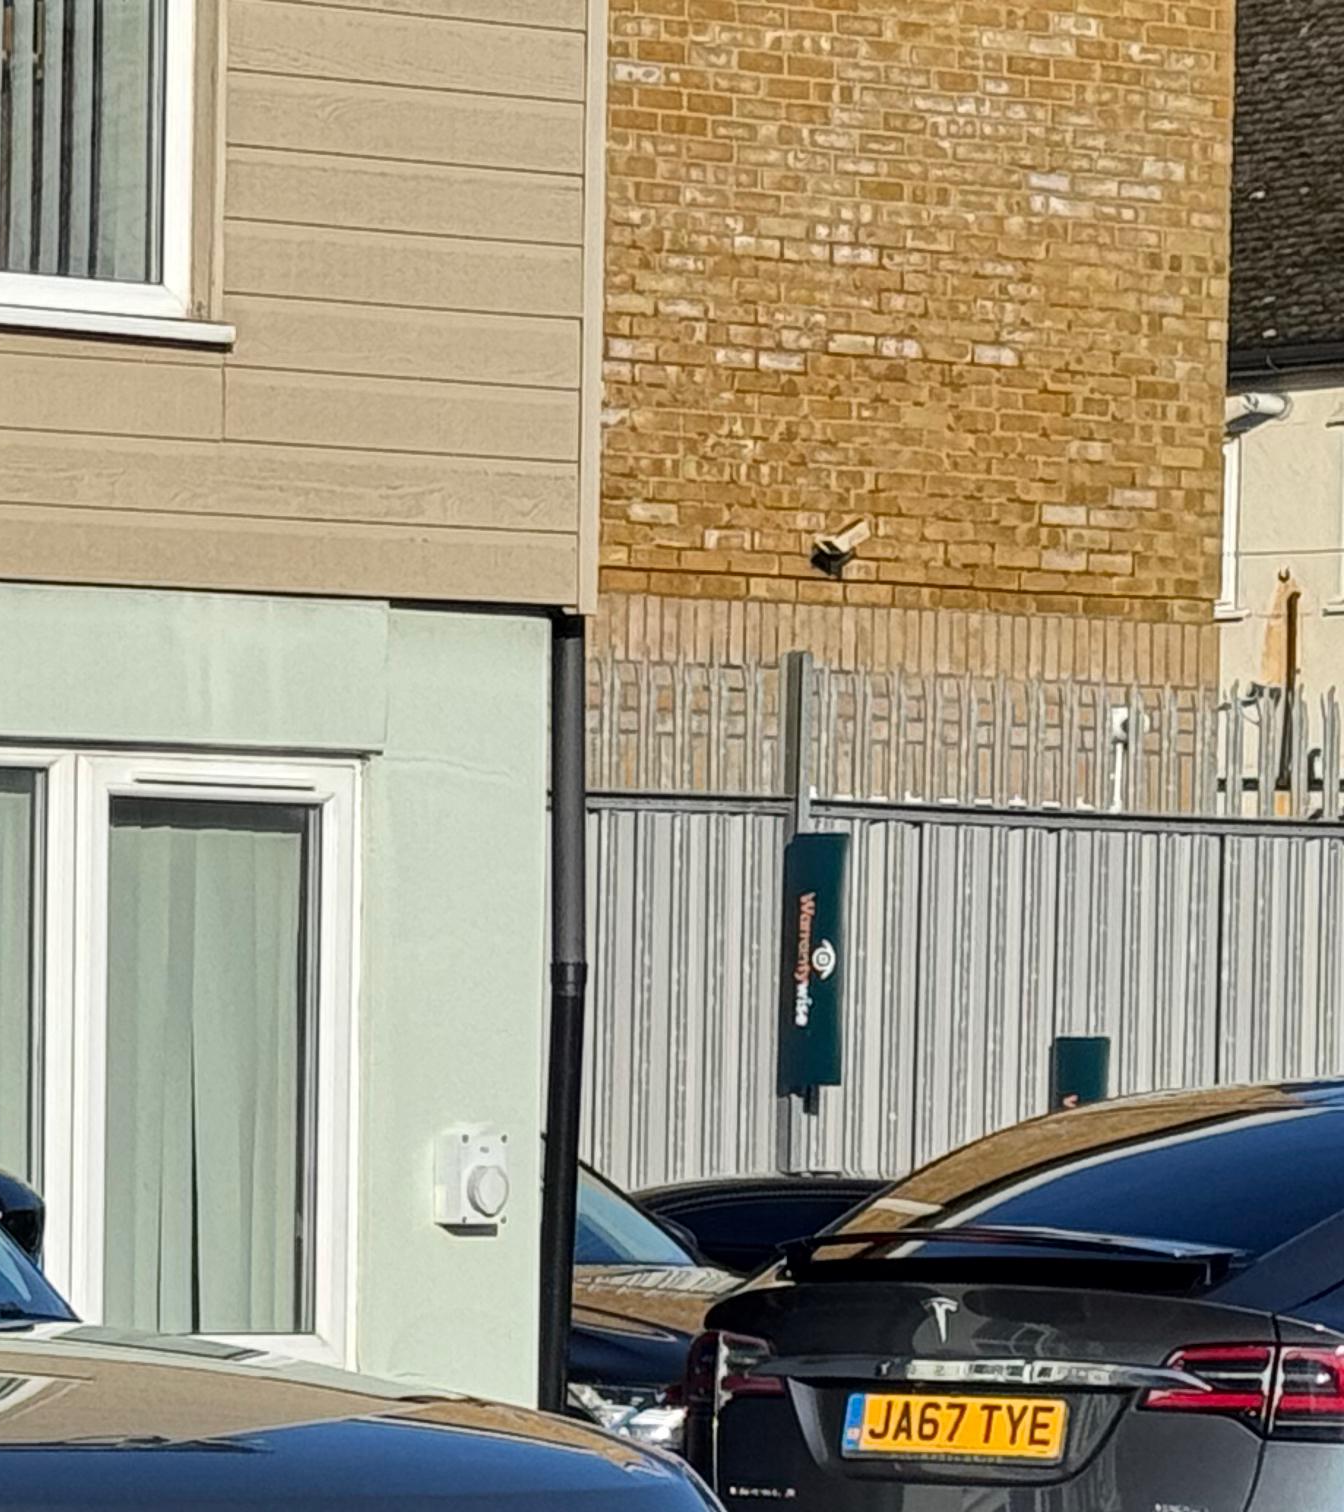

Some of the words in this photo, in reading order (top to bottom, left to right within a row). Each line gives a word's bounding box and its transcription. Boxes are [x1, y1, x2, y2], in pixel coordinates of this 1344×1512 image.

[794, 892, 816, 1027] Warrantywise
[868, 1400, 967, 1441] JA67
[980, 1404, 1055, 1446] TYE
